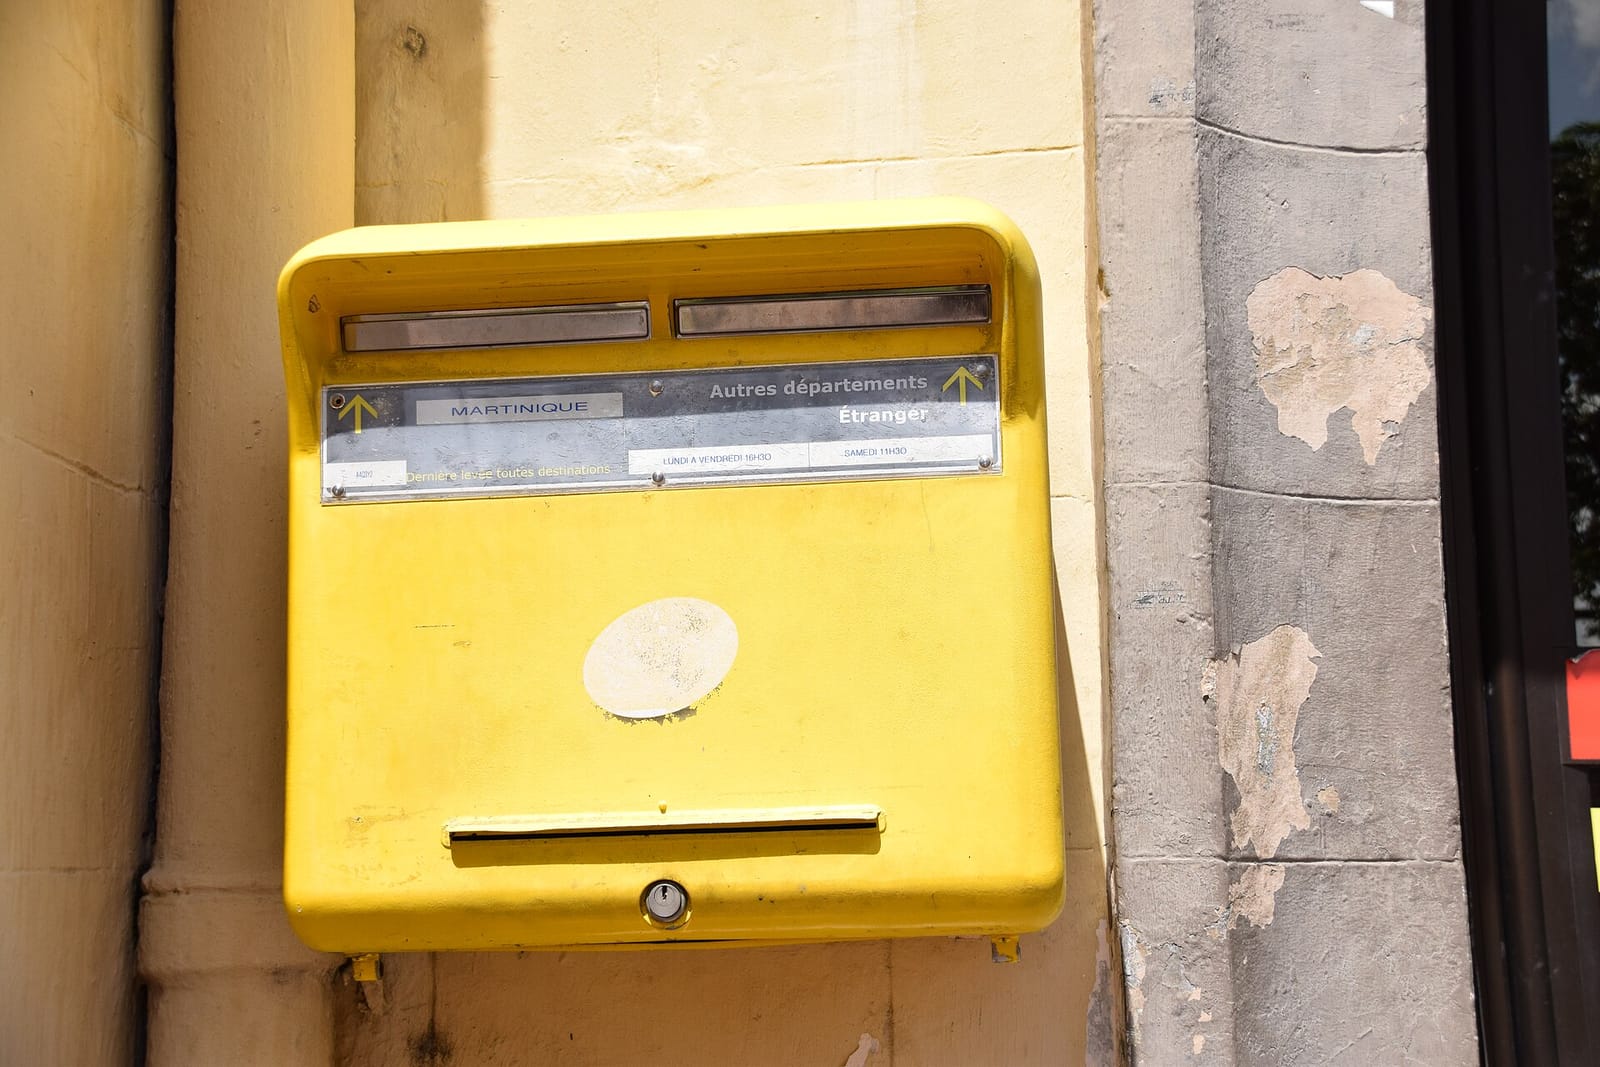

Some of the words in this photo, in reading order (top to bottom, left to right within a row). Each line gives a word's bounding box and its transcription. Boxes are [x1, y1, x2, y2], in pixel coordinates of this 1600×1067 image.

[709, 383, 777, 399] Autres
[783, 375, 928, 397] départements
[451, 401, 588, 417] MARTINIQUE
[839, 404, 928, 424] Étranger
[663, 457, 689, 465] LUNDI
[699, 455, 743, 464] VENDREDI
[745, 453, 772, 462] 16H30
[844, 449, 878, 457] SAMEDI
[880, 447, 907, 456] 11H30
[496, 466, 534, 478] toutes
[538, 464, 611, 476] destinations
